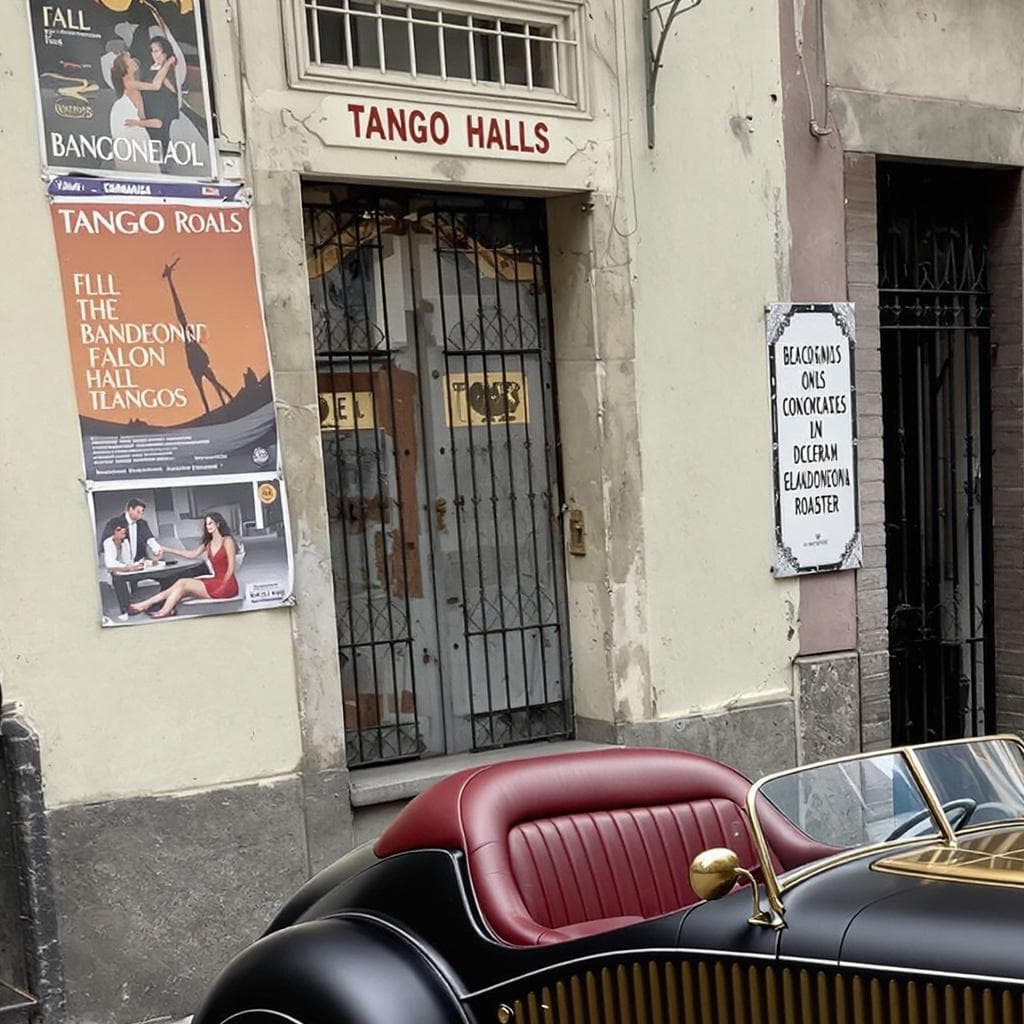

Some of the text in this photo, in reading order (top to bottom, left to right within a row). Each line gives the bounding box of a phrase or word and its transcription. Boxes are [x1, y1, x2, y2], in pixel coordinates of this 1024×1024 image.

[347, 103, 550, 154] TANGO HALLS
[58, 209, 243, 235] TANGO ROALS
[76, 299, 119, 321] THE
[88, 345, 166, 369] FALON
[86, 369, 139, 389] HALL
[794, 494, 839, 515] ROASTER
